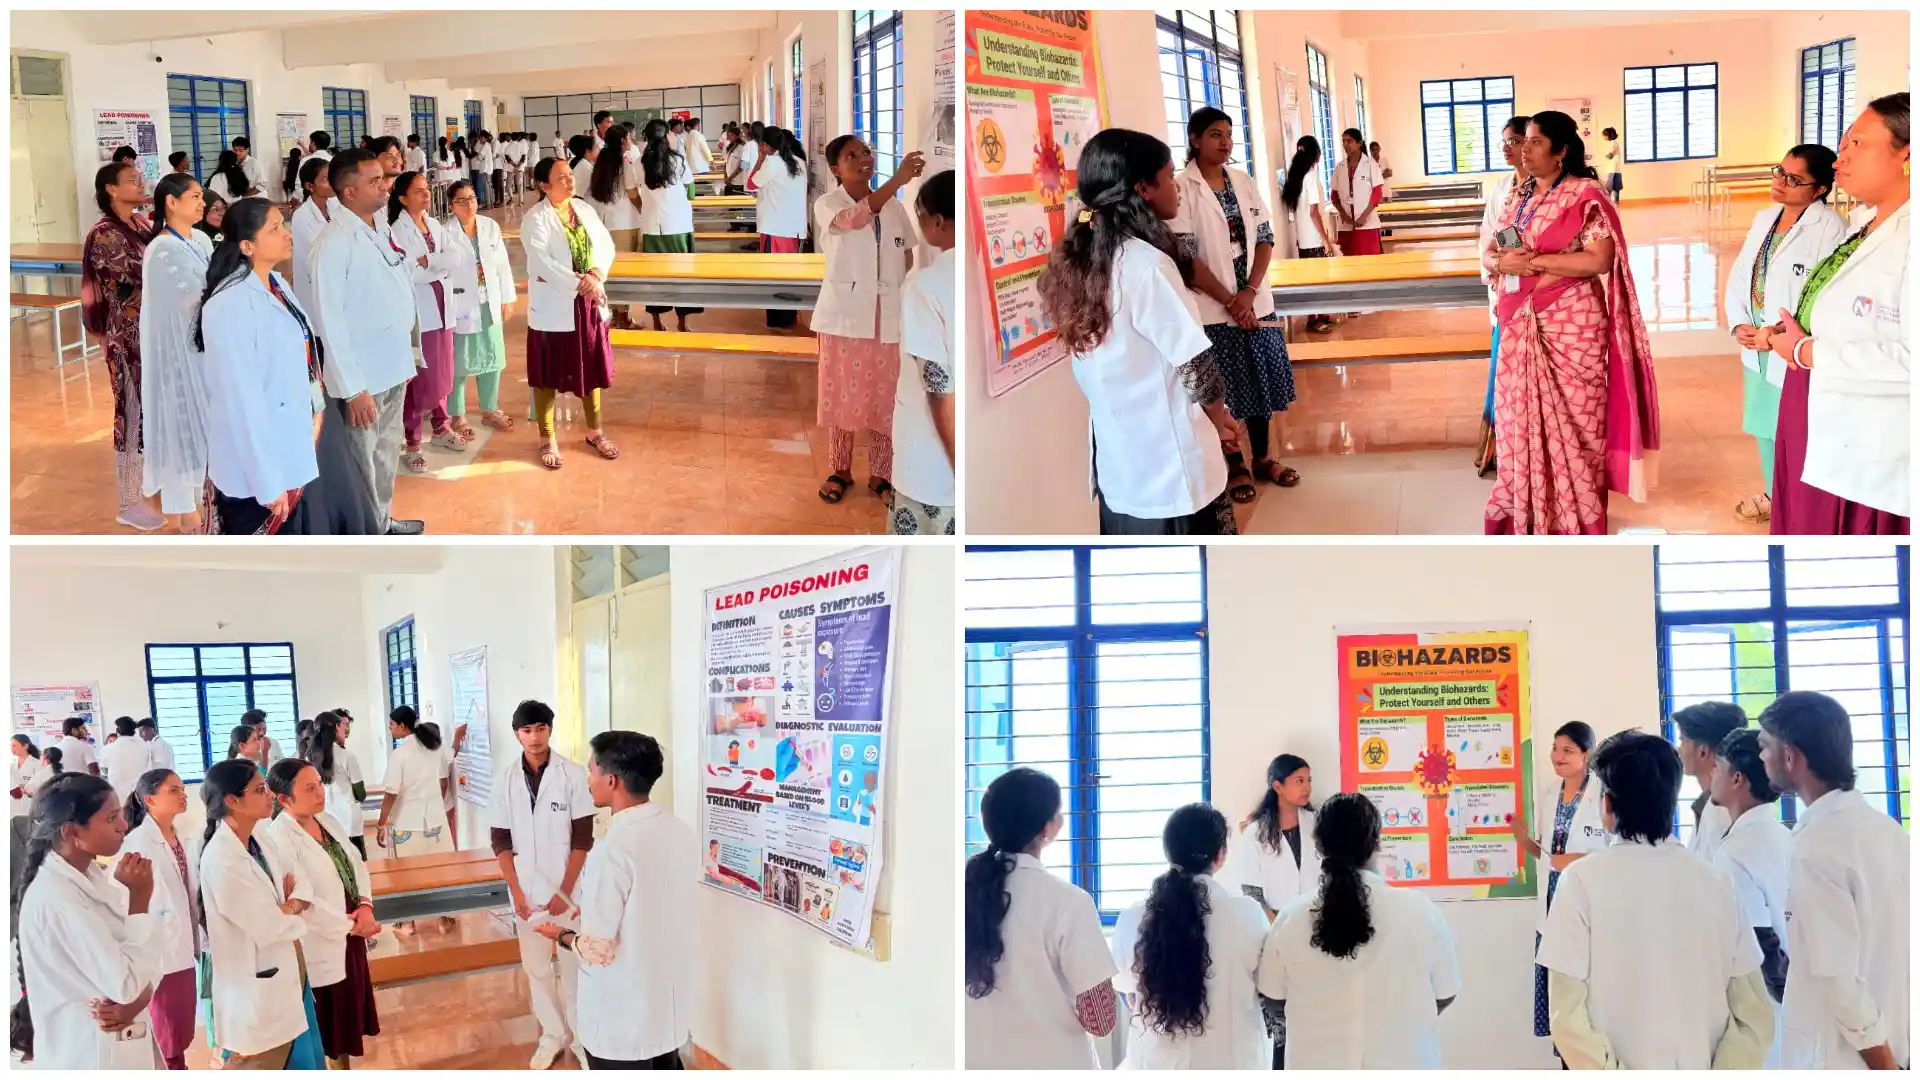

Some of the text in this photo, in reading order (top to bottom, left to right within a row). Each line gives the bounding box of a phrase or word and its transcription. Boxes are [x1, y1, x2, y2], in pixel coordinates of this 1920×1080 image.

[983, 35, 1079, 67] Understanding Biohazards:
[986, 56, 1081, 84] Protect Yourself and Others
[715, 564, 869, 611] LEAD POISONING
[779, 592, 886, 620] CAUSES SYMPTOMS
[712, 615, 756, 632] DEFINITION
[817, 612, 871, 628] Symptoms of lead
[708, 663, 771, 676] COMPLICATIONS
[1379, 685, 1489, 697] Understanding Biohazards:
[1379, 696, 1490, 708] Protect Yourself and Others
[775, 721, 882, 732] DIAGNOSTIC EVALUATION
[779, 784, 822, 795] MANAGEMENT
[706, 795, 762, 814] TREATMENT
[775, 791, 794, 800] BASED
[805, 796, 825, 805] BLOOD
[767, 852, 827, 879] PREVENTION
